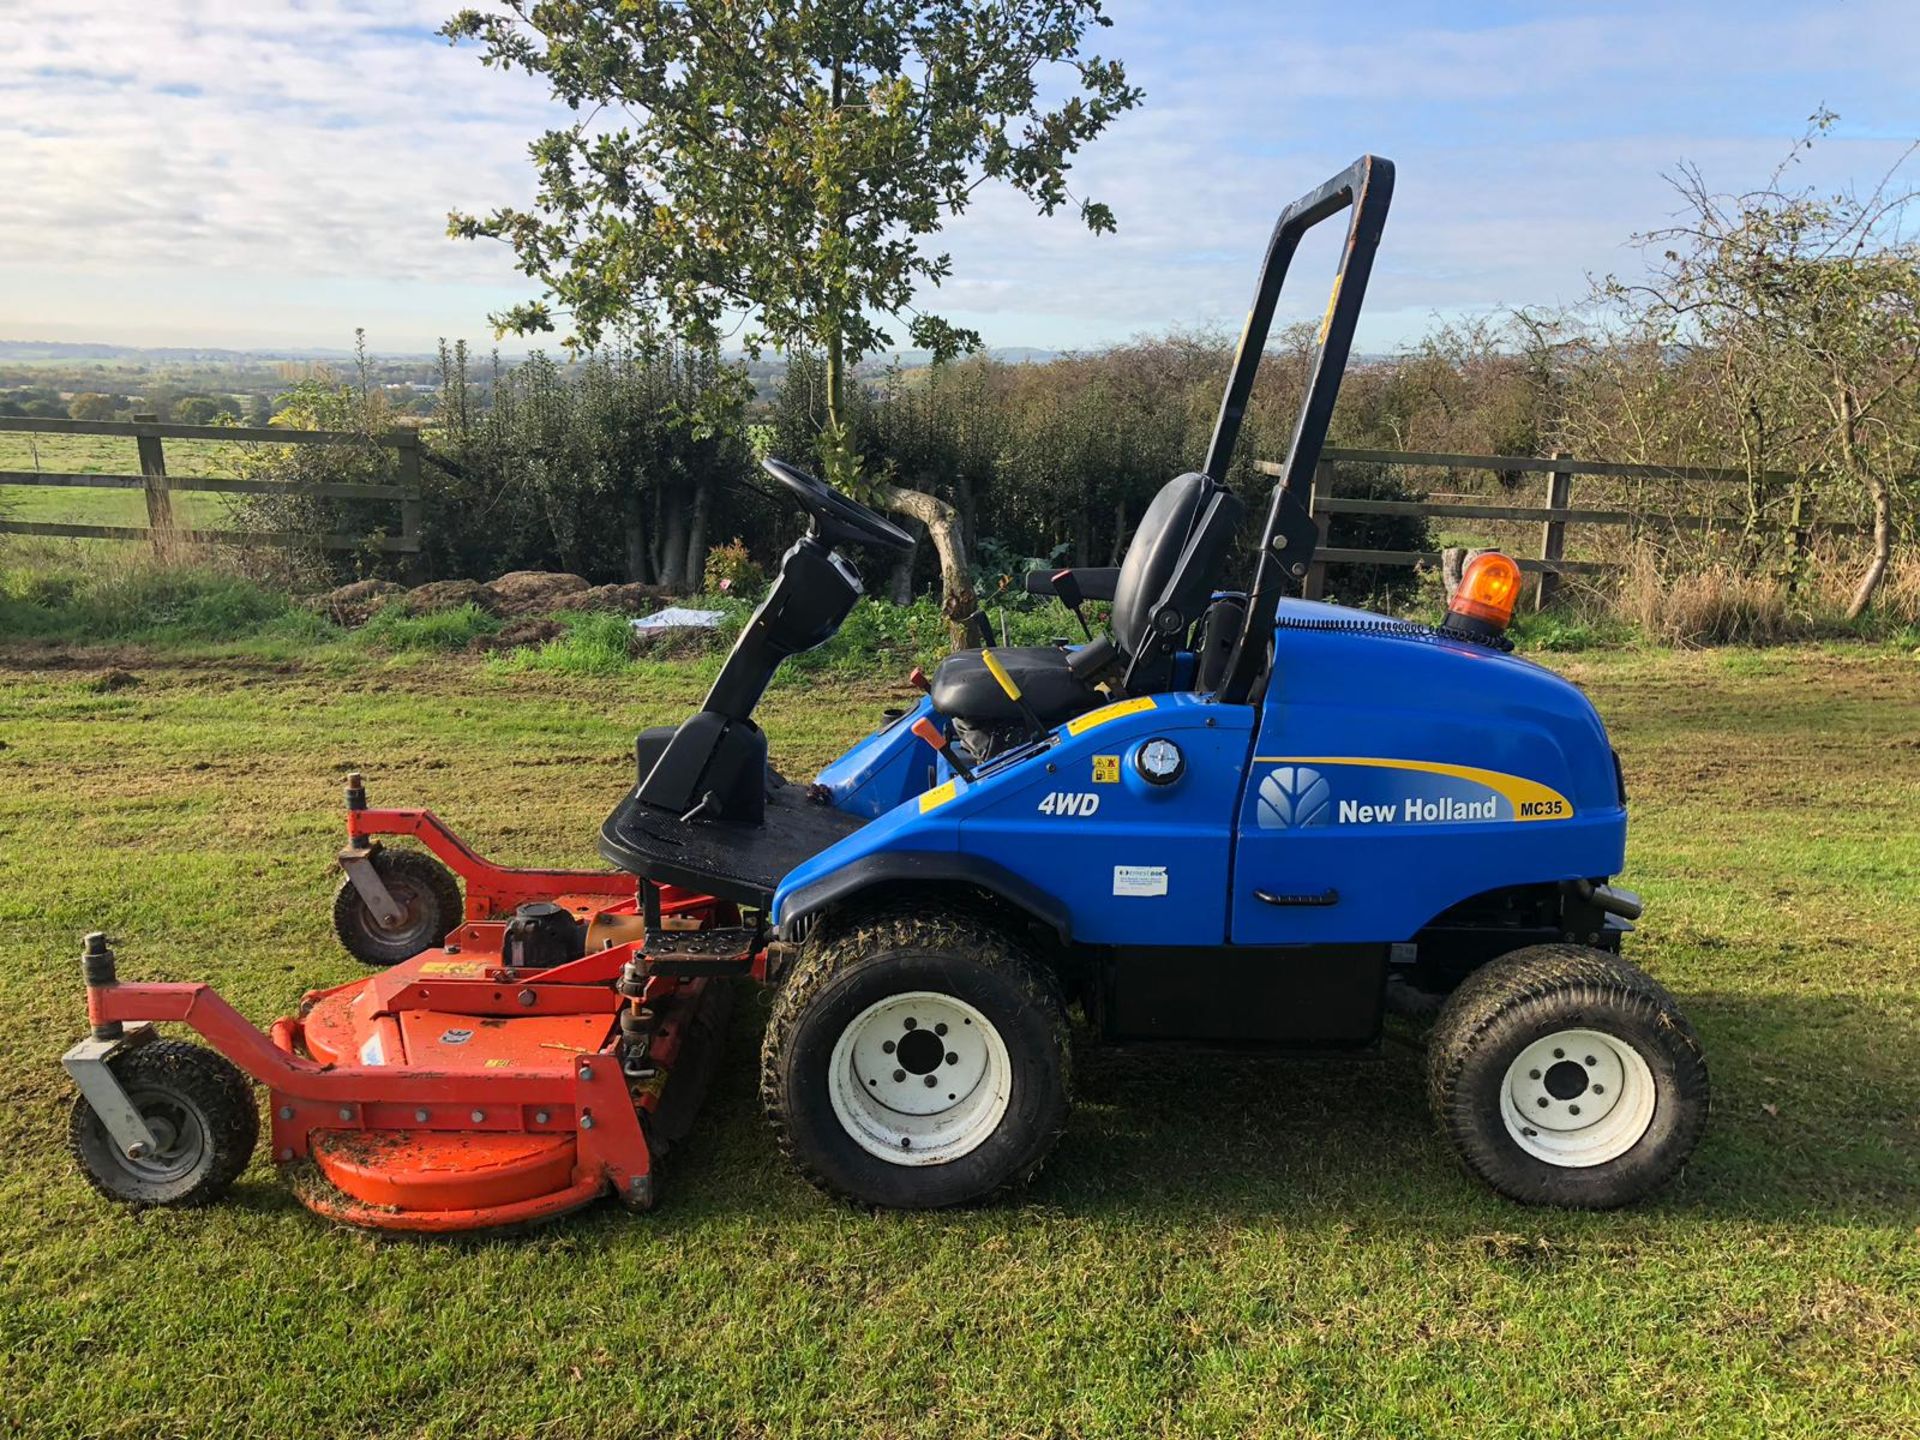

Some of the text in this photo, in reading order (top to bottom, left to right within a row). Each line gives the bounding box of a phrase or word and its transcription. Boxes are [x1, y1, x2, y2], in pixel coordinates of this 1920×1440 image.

[1038, 792, 1100, 816] 4WD
[1339, 796, 1497, 823] New Holland
[1521, 801, 1562, 816] MC35
